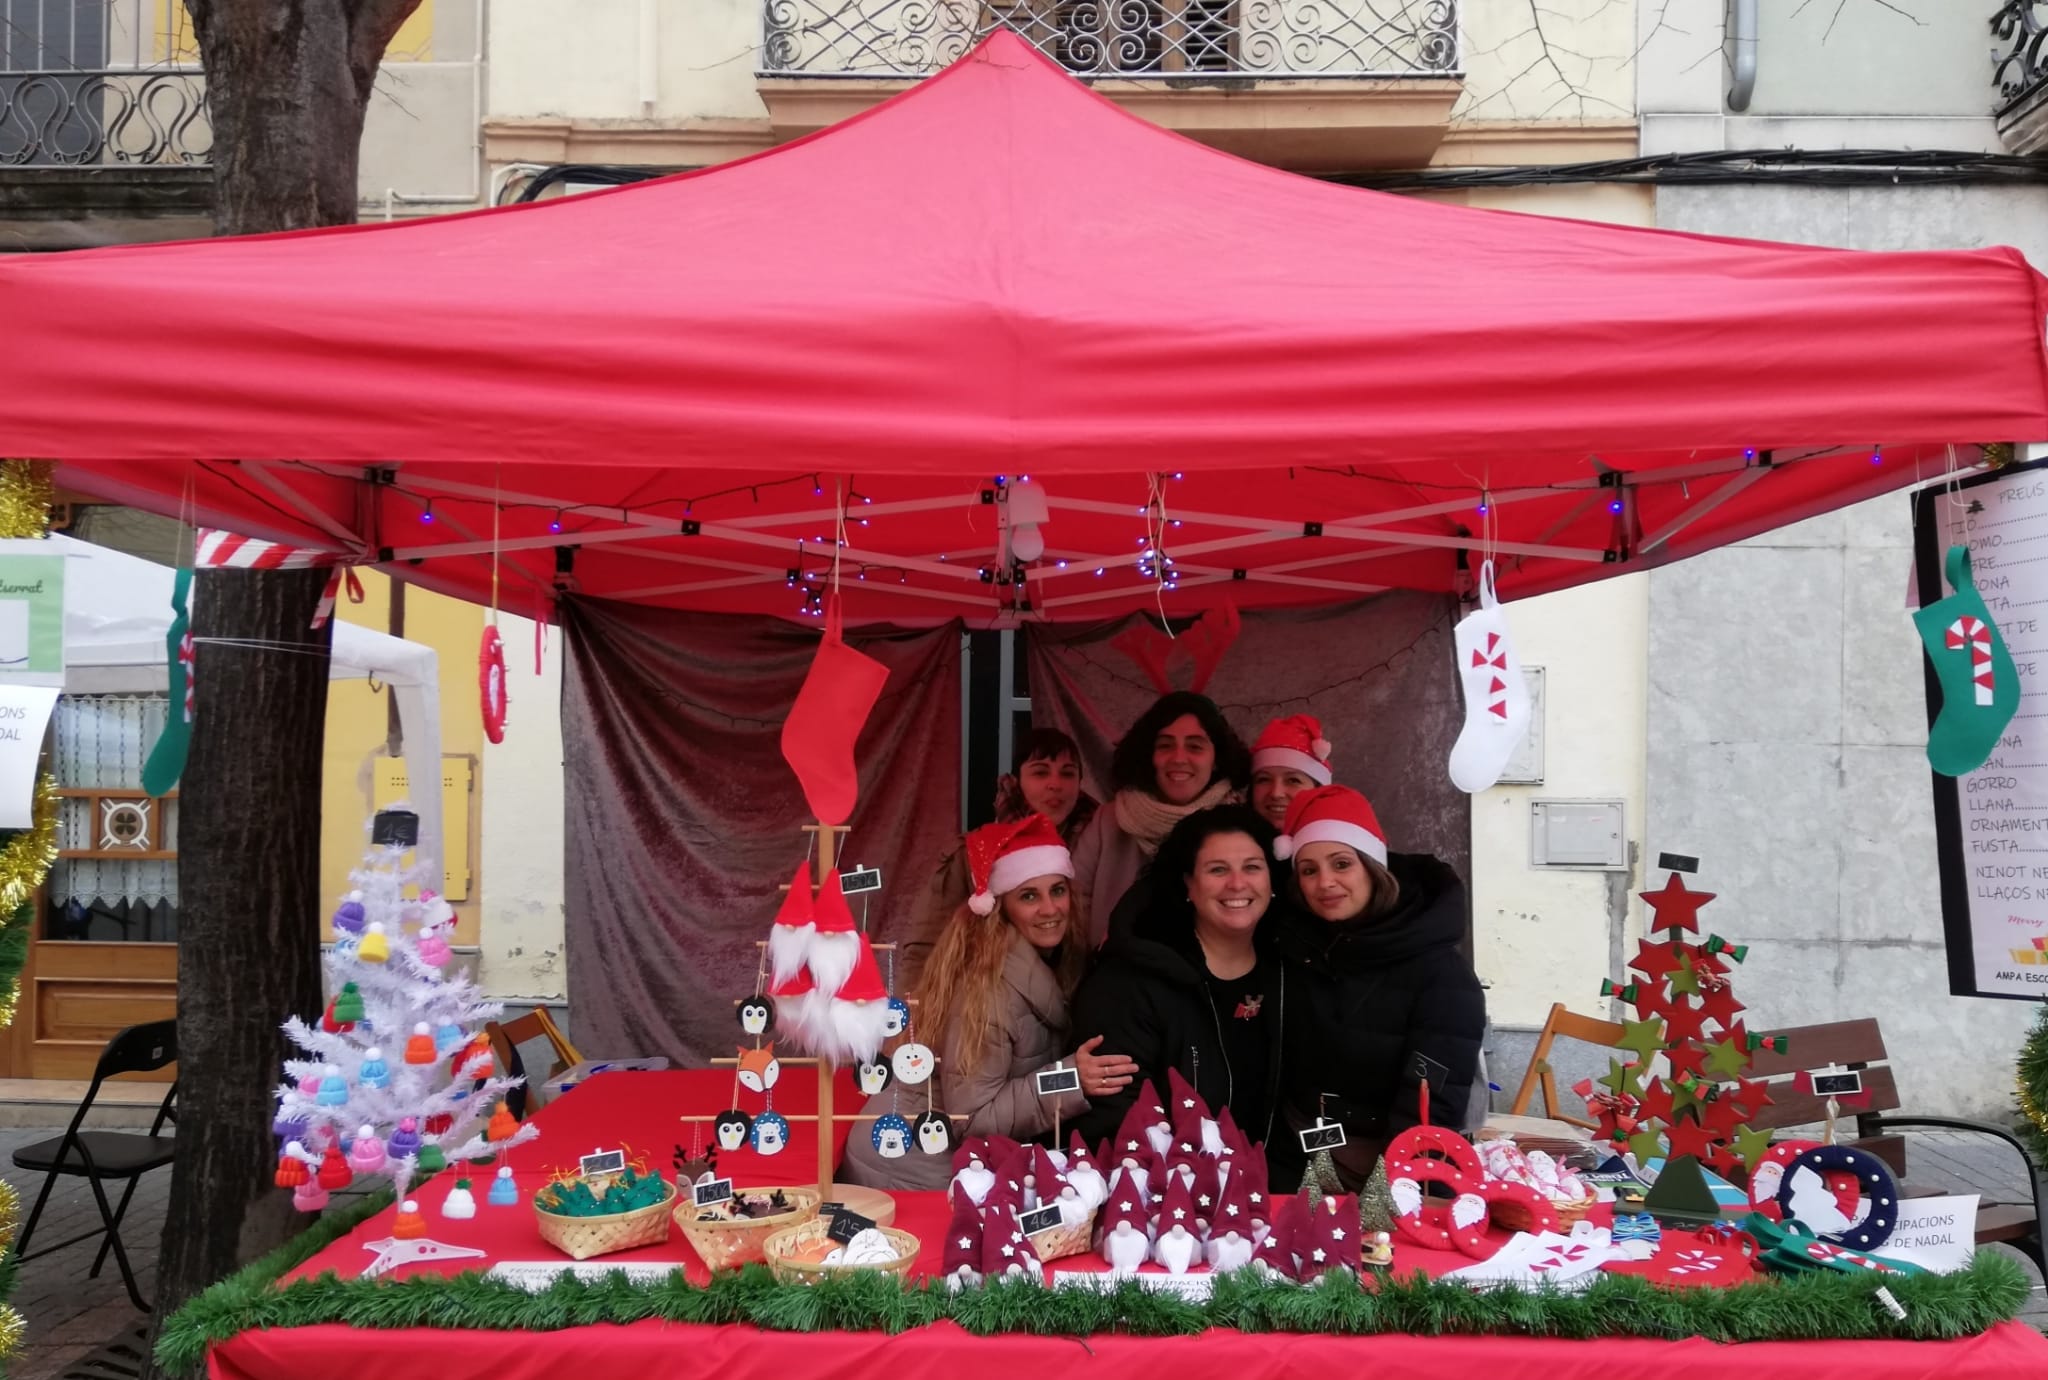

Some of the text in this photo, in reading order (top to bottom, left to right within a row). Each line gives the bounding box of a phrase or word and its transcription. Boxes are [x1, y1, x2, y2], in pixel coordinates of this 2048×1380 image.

[1998, 482, 2046, 504] PREUS
[1967, 534, 2003, 552] OMO
[2017, 620, 2039, 634] DE
[1966, 776, 2017, 793] GORRO
[1969, 797, 2015, 812] LLANA
[1970, 838, 2019, 853] FUSTA
[1975, 865, 2027, 879] NINOT
[1977, 885, 2032, 901] LLAÇOS
[1995, 970, 2023, 982] AMPA
[1894, 1237, 1911, 1249] DE
[1915, 1233, 1956, 1248] NADAL
